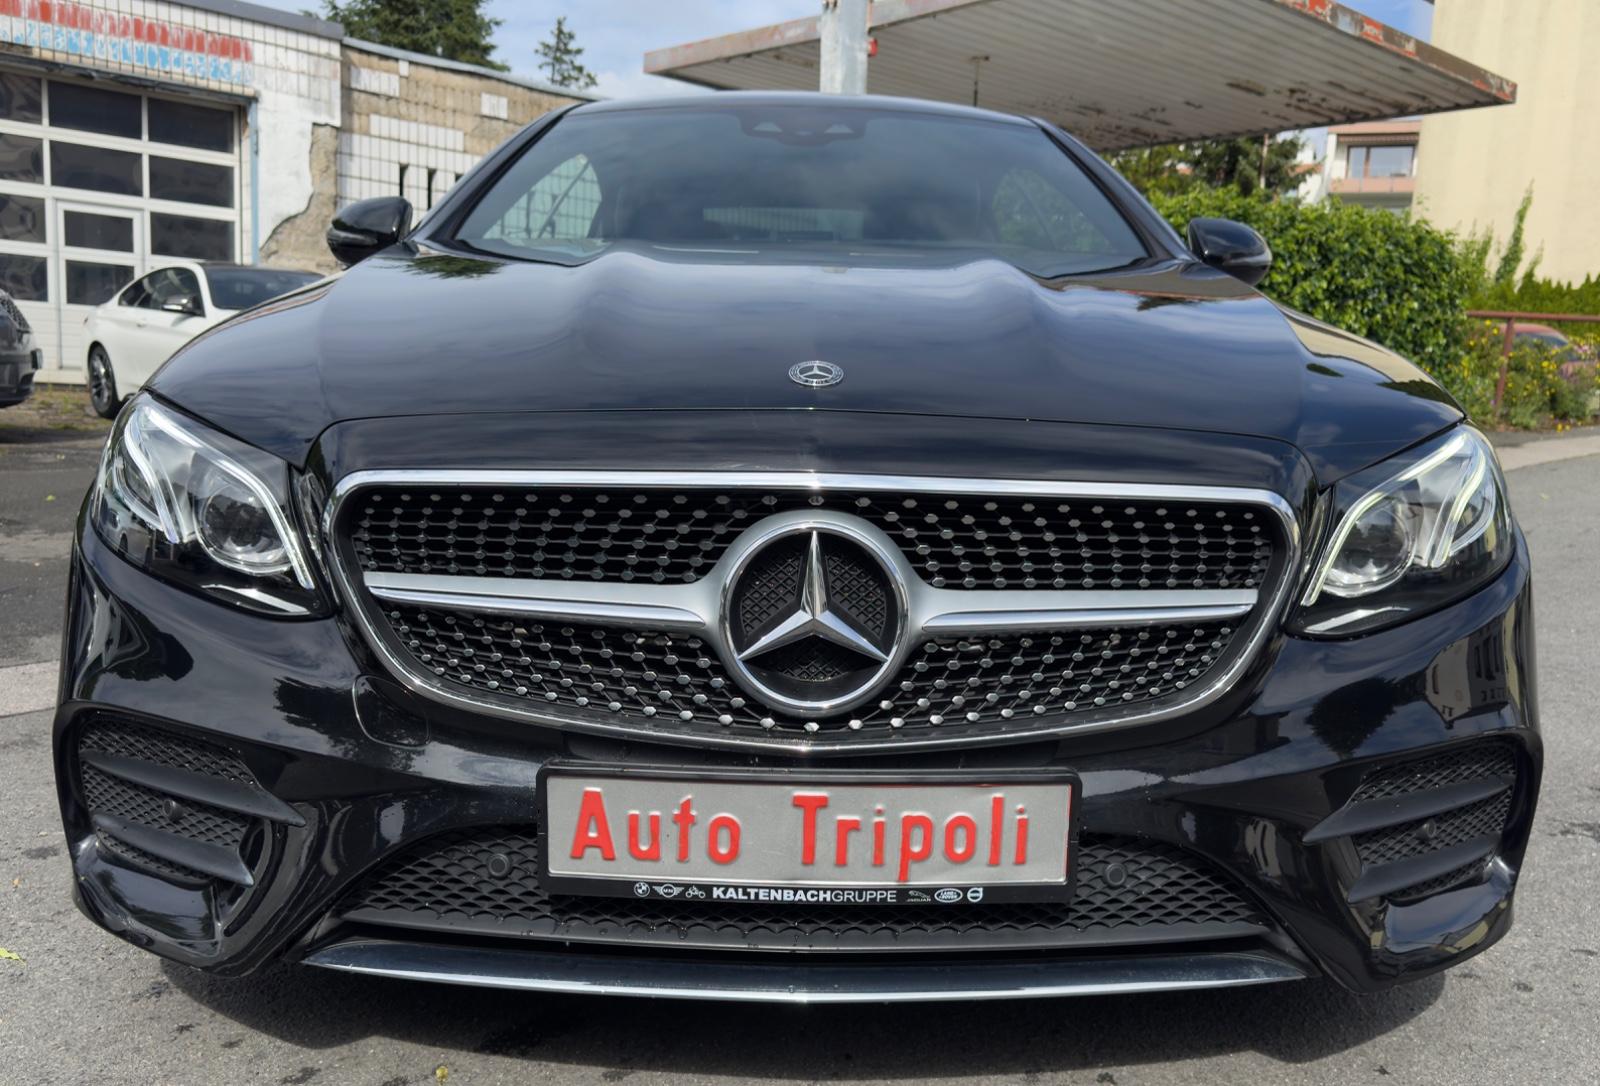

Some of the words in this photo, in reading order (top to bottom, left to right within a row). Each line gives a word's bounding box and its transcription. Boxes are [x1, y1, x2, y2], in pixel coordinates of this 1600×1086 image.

[570, 787, 742, 865] Auto
[791, 791, 1029, 883] Tripoli
[712, 886, 897, 902] KALTENBACHGRUPPE
